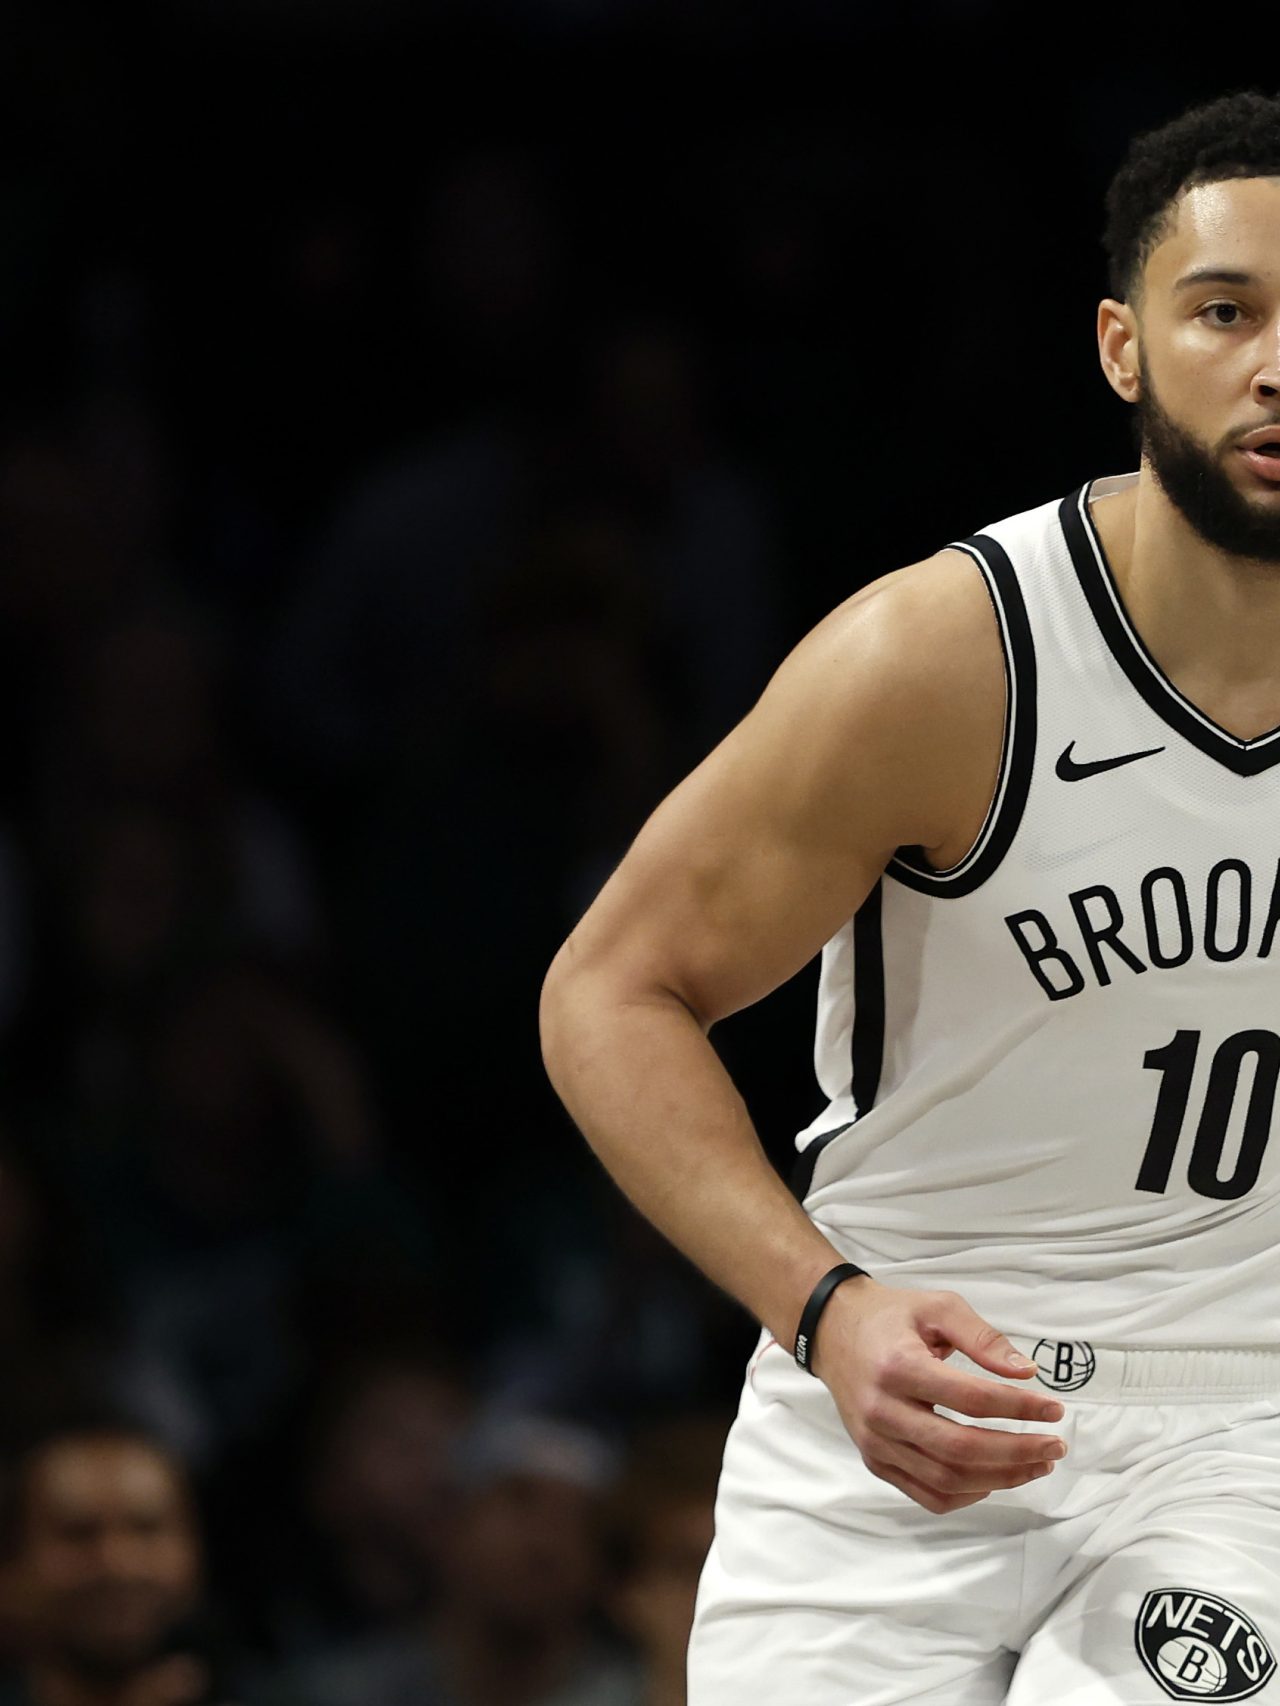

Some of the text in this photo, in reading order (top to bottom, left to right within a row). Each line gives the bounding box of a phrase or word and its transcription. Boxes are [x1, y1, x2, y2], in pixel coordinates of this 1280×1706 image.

[1054, 1341, 1074, 1383] B
[1145, 1593, 1269, 1683] NETS
[1176, 1646, 1209, 1686] B
